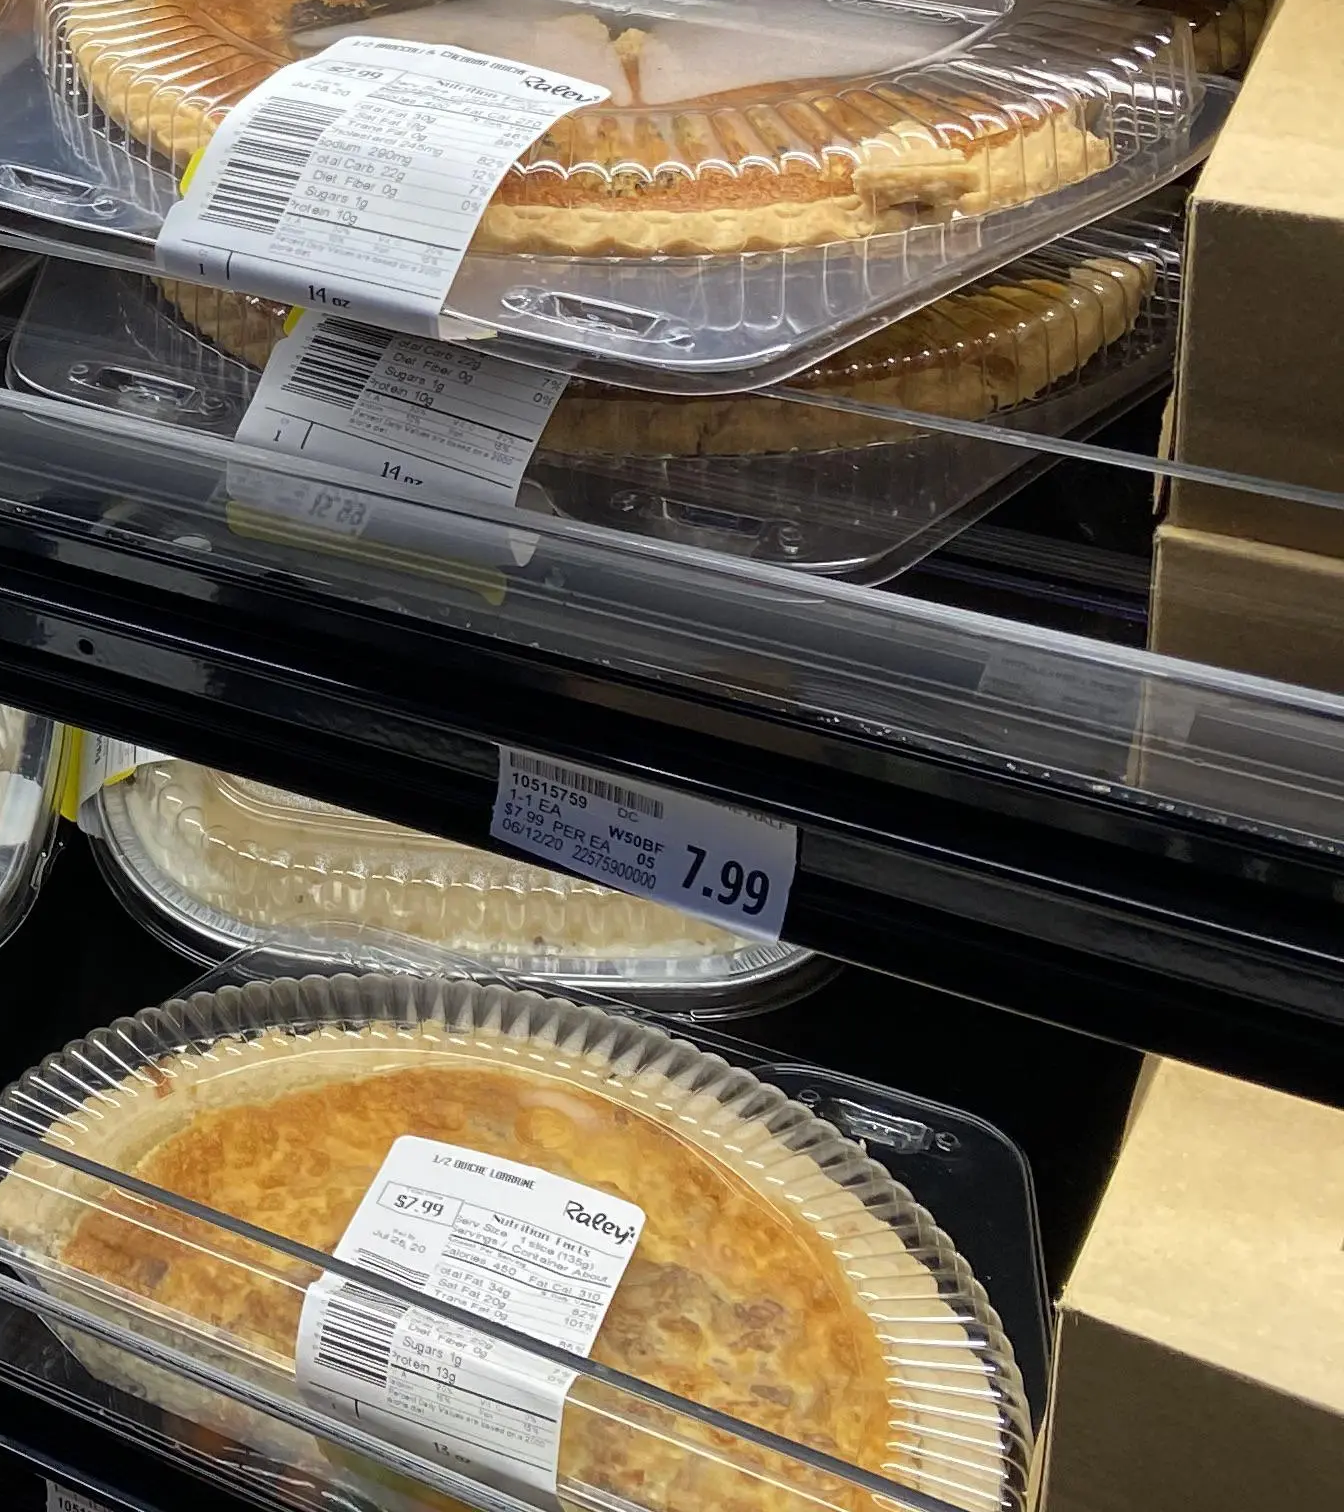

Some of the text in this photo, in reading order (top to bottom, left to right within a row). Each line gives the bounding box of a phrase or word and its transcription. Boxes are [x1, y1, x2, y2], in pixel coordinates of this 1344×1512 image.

[309, 284, 327, 303] 14
[380, 461, 402, 482] 14
[511, 772, 588, 809] 10515759
[502, 818, 564, 852] 06/12/20
[553, 820, 585, 844] PER
[590, 833, 611, 853] EA
[681, 843, 770, 916] 7.99
[393, 1193, 445, 1217] $7.99
